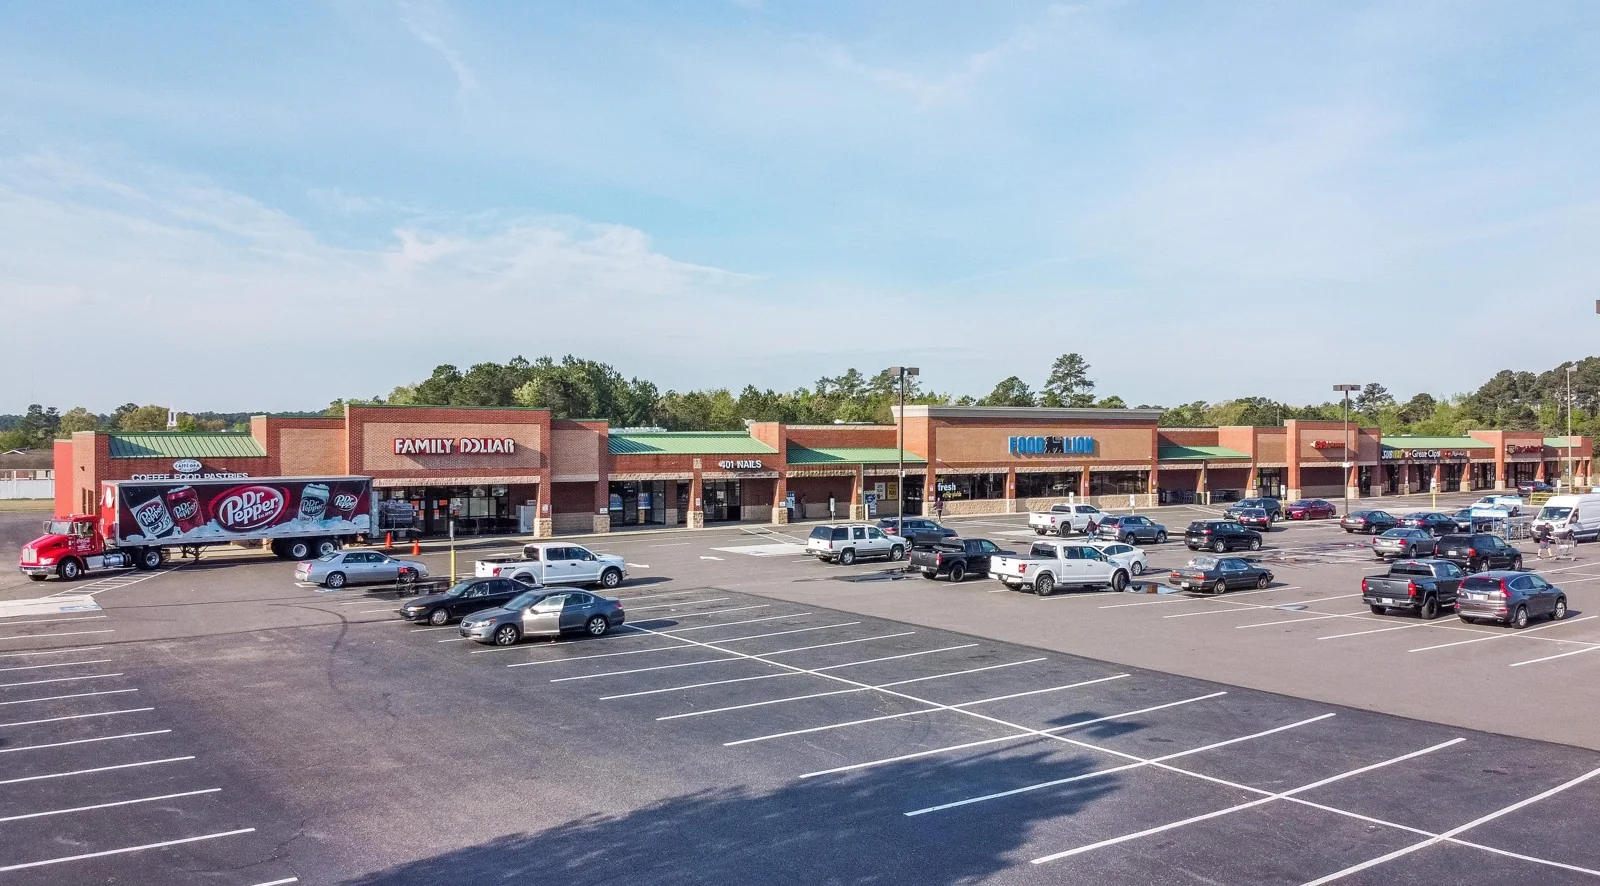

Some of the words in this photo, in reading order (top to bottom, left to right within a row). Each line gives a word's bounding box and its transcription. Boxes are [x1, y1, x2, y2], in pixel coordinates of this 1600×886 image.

[394, 438, 454, 454] FAMILY
[459, 438, 516, 454] DOLLAR
[1008, 435, 1044, 454] FOOD
[1063, 435, 1094, 454] LION
[718, 459, 734, 469] 401
[736, 459, 762, 469] NAILS
[204, 472, 249, 480] PASTRIES
[937, 482, 956, 491] fresh
[180, 502, 191, 512] Dr
[242, 491, 265, 509] Dr
[302, 500, 325, 513] Pepper
[139, 504, 163, 525] Pepper
[145, 504, 156, 515] Dr
[173, 501, 196, 519] Pepper
[219, 496, 279, 526] Pepper
